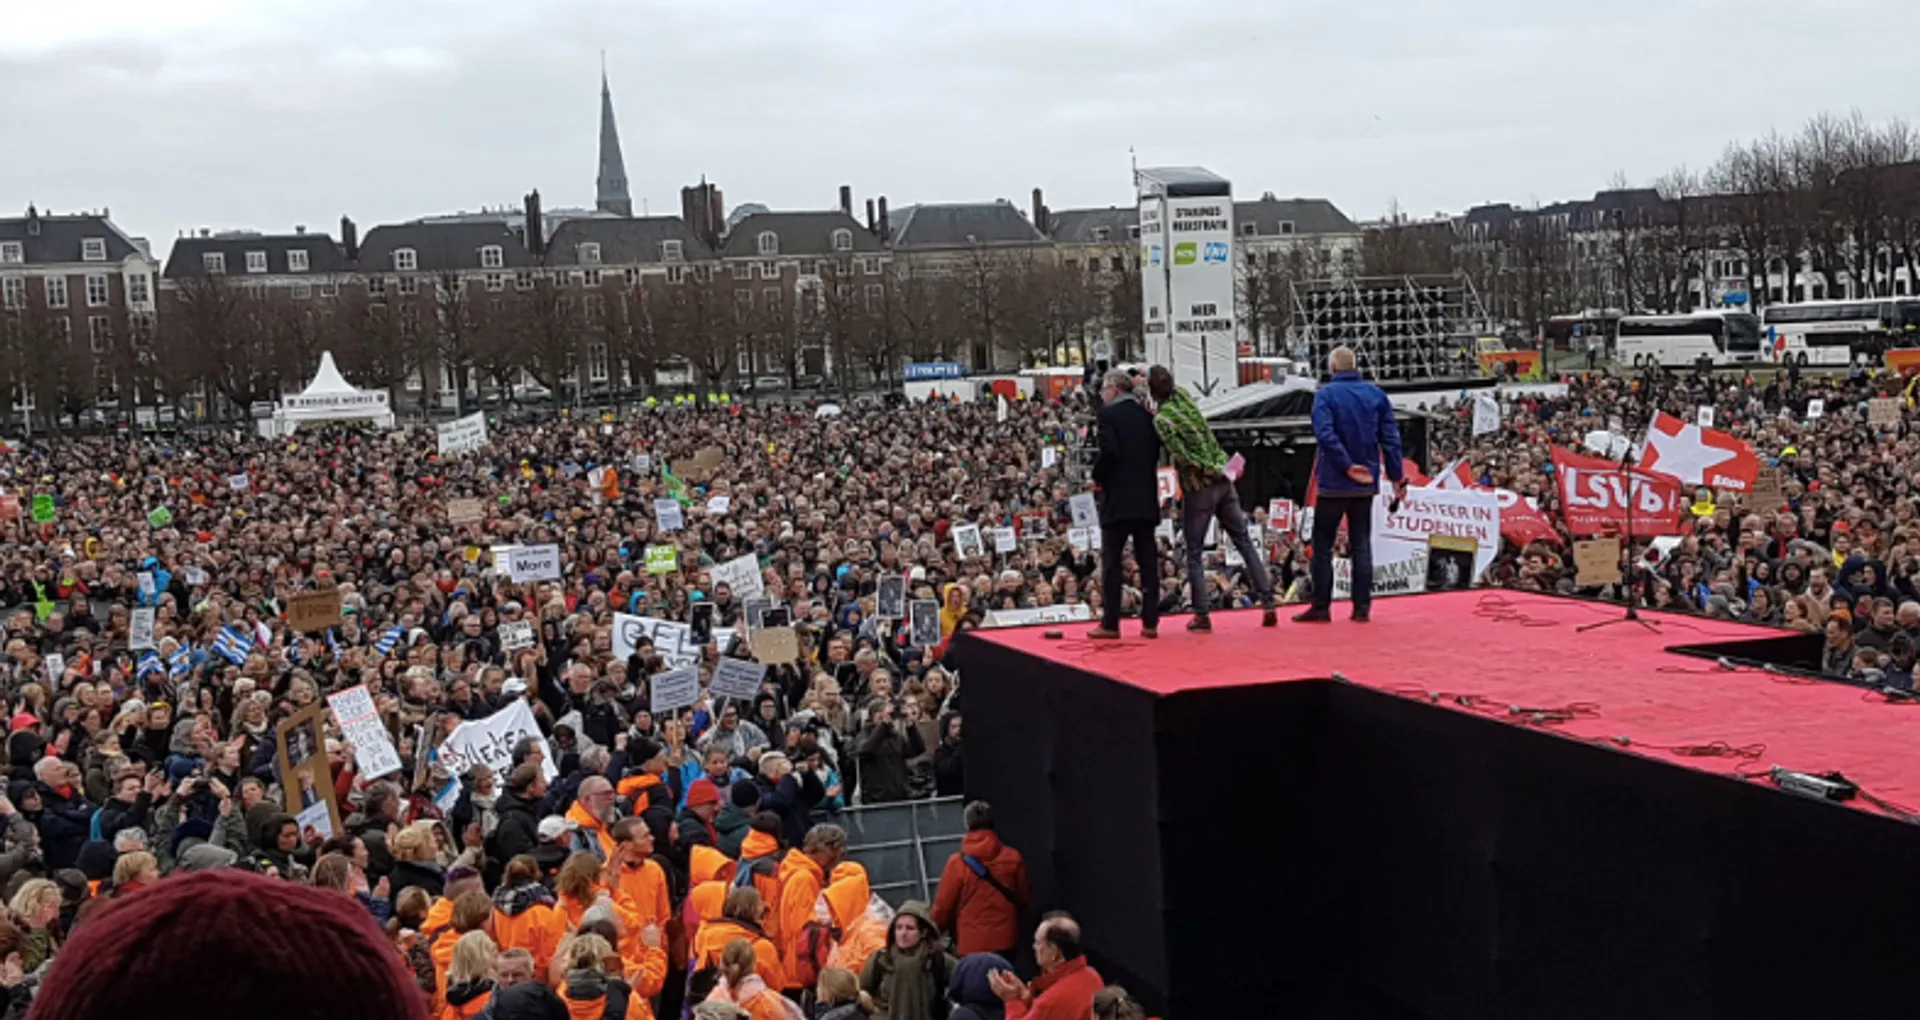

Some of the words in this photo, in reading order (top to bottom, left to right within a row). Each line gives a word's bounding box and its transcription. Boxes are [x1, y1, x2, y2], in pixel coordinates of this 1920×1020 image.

[1472, 506, 1492, 521] IN
[1385, 515, 1488, 540] STUDENTEN
[515, 559, 552, 572] More
